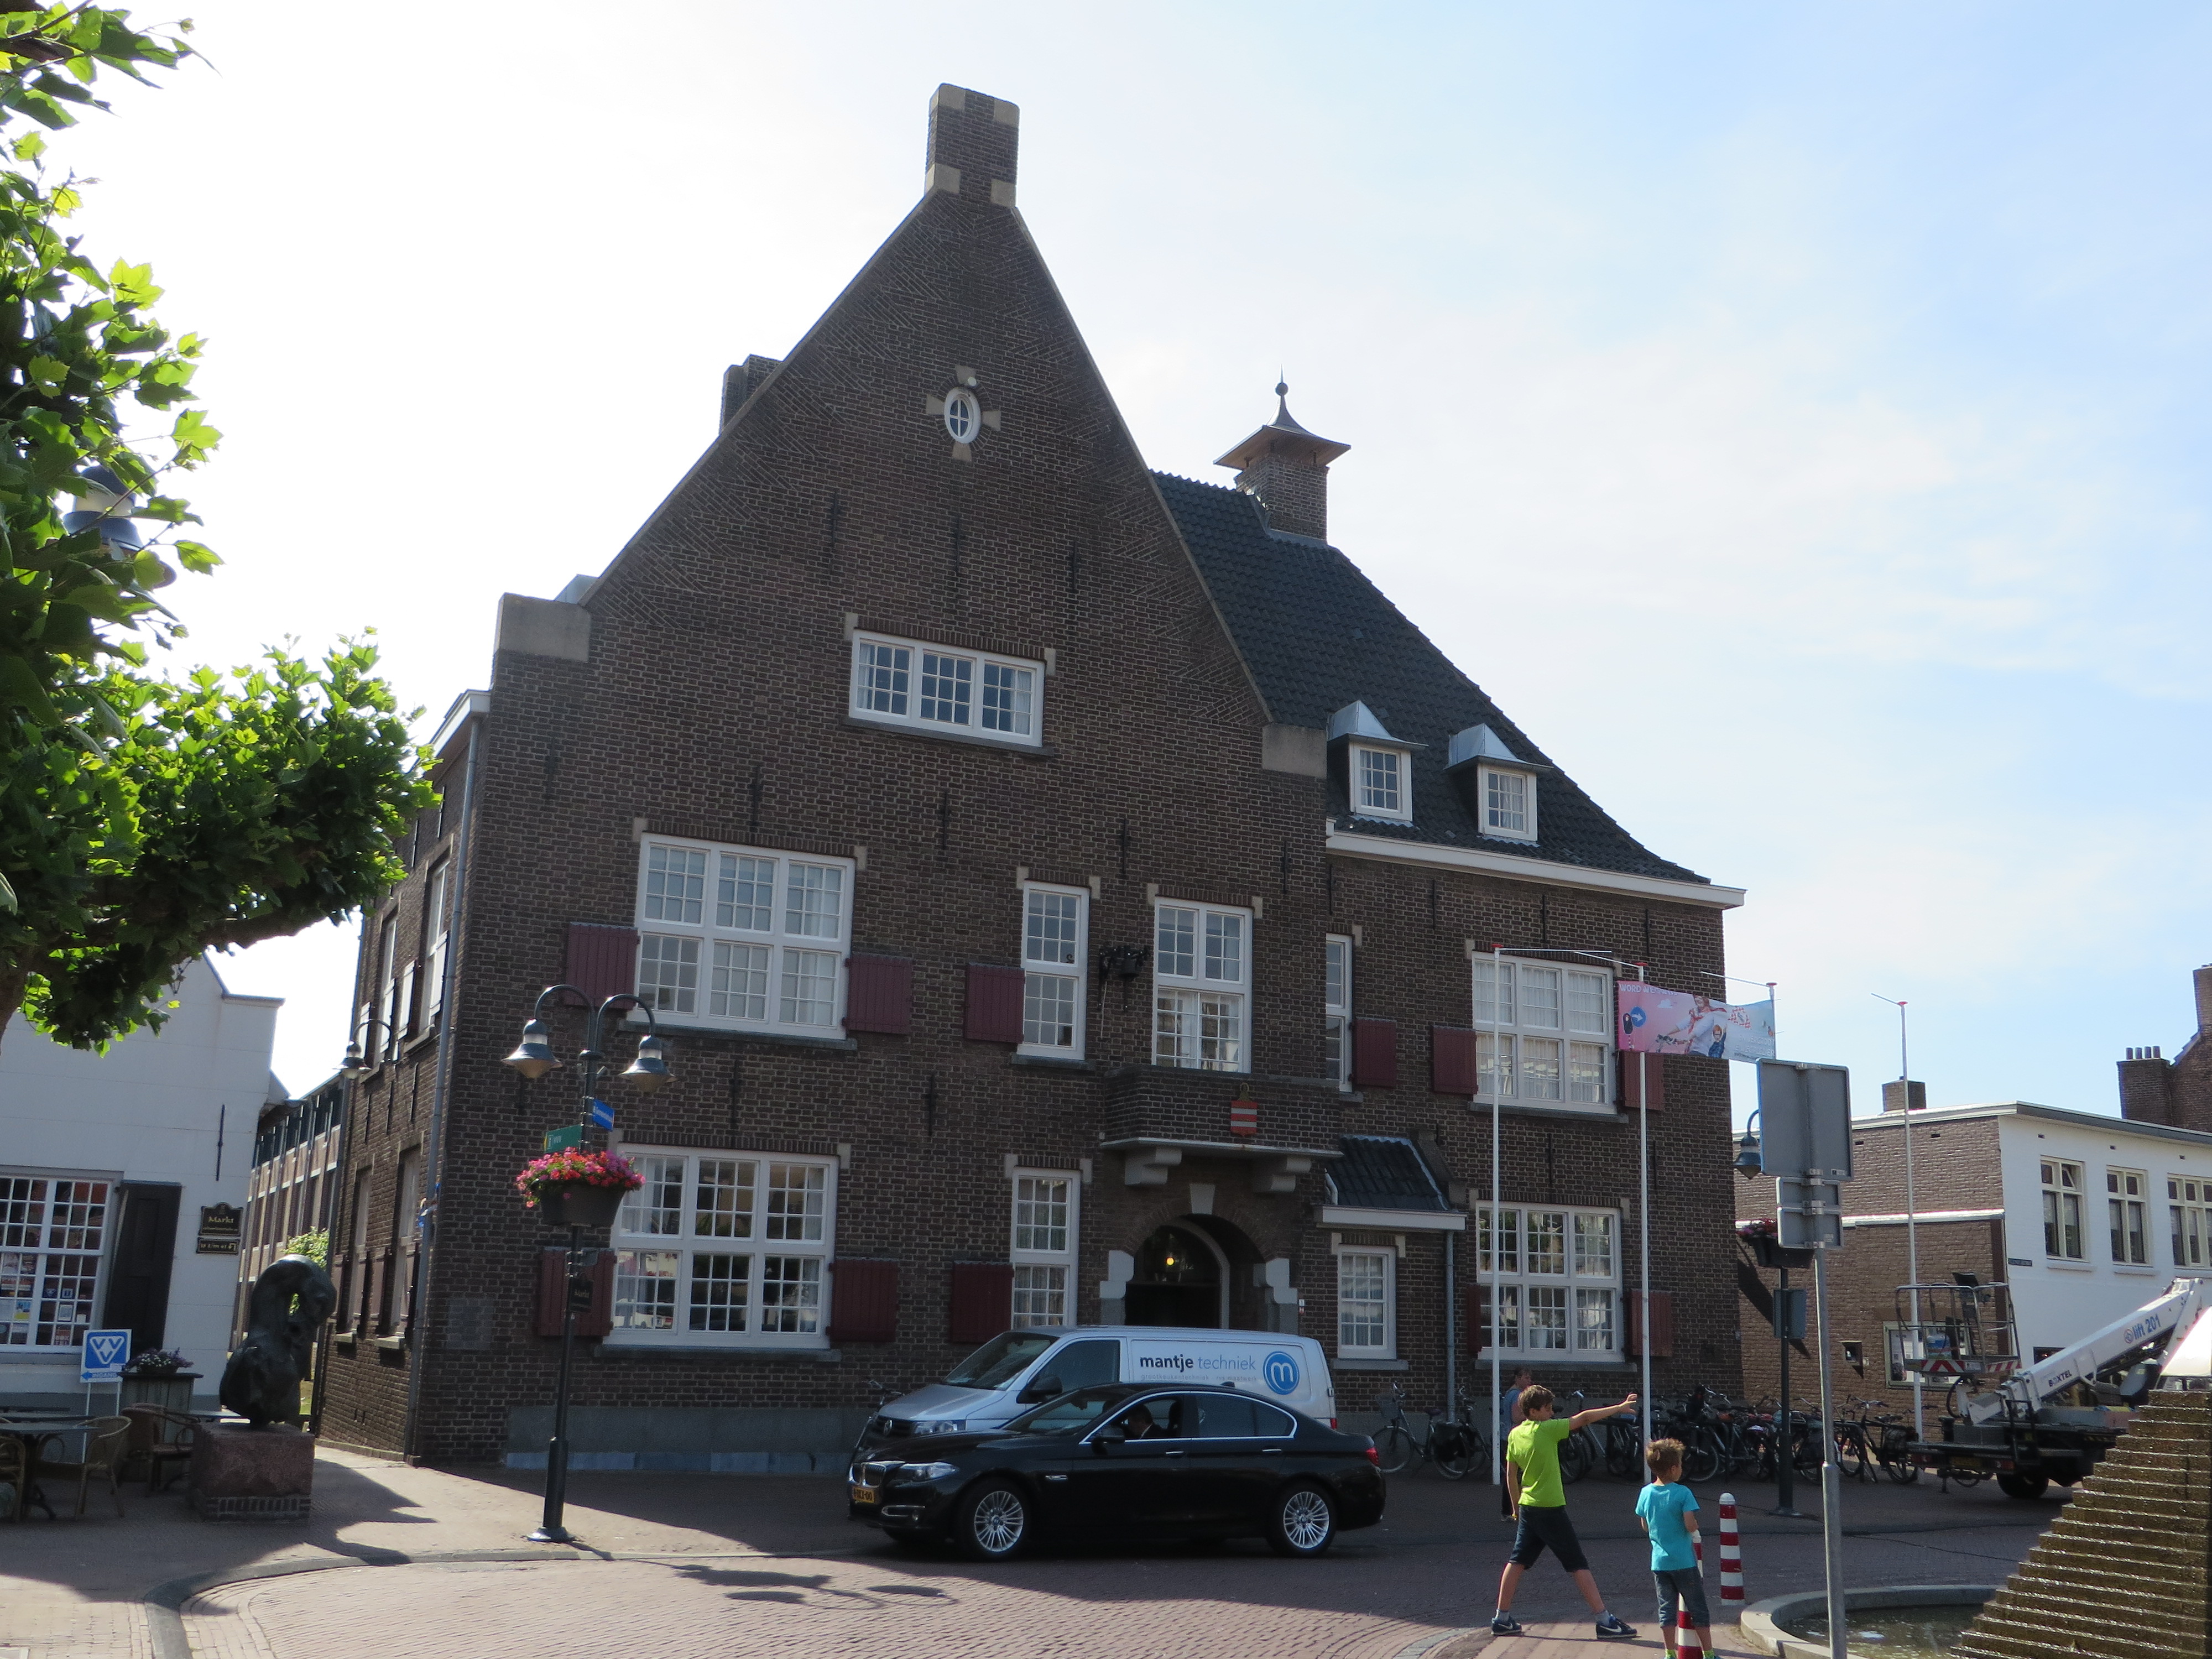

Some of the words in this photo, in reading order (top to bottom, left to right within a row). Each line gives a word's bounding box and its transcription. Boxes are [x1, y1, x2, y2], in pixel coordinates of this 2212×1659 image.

[1619, 984, 1641, 993] WORD
[2132, 1323, 2146, 1339] lift
[2145, 1313, 2161, 1333] 201
[1140, 1354, 1194, 1373] mantje
[1198, 1354, 1256, 1370] techniek
